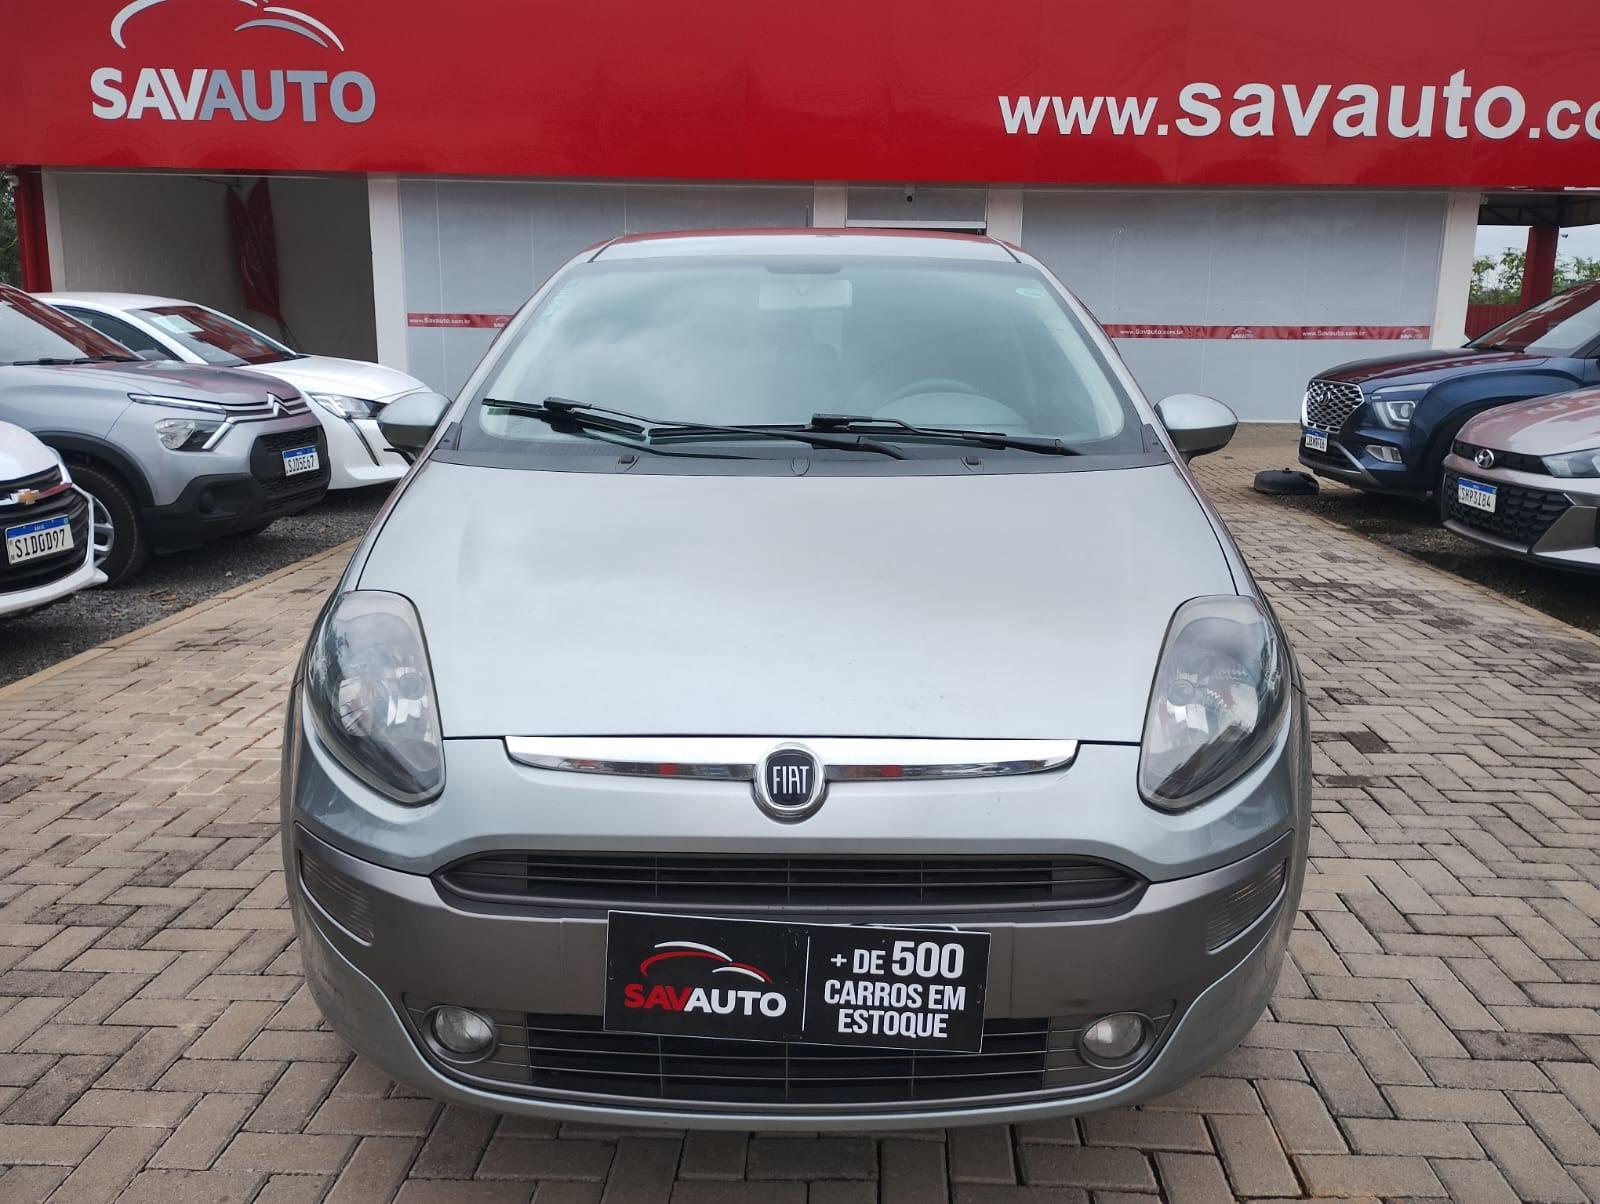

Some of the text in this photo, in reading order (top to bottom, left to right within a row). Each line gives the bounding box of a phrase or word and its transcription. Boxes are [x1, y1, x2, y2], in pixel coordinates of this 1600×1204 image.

[90, 66, 376, 124] SAVAUTO
[772, 765, 810, 794] FIAT
[853, 948, 886, 975] DE
[891, 940, 965, 979] 500
[624, 983, 787, 1018] SAVAUTO
[824, 978, 966, 1011] CARROS EM
[838, 1008, 949, 1039] ESTOQUE
